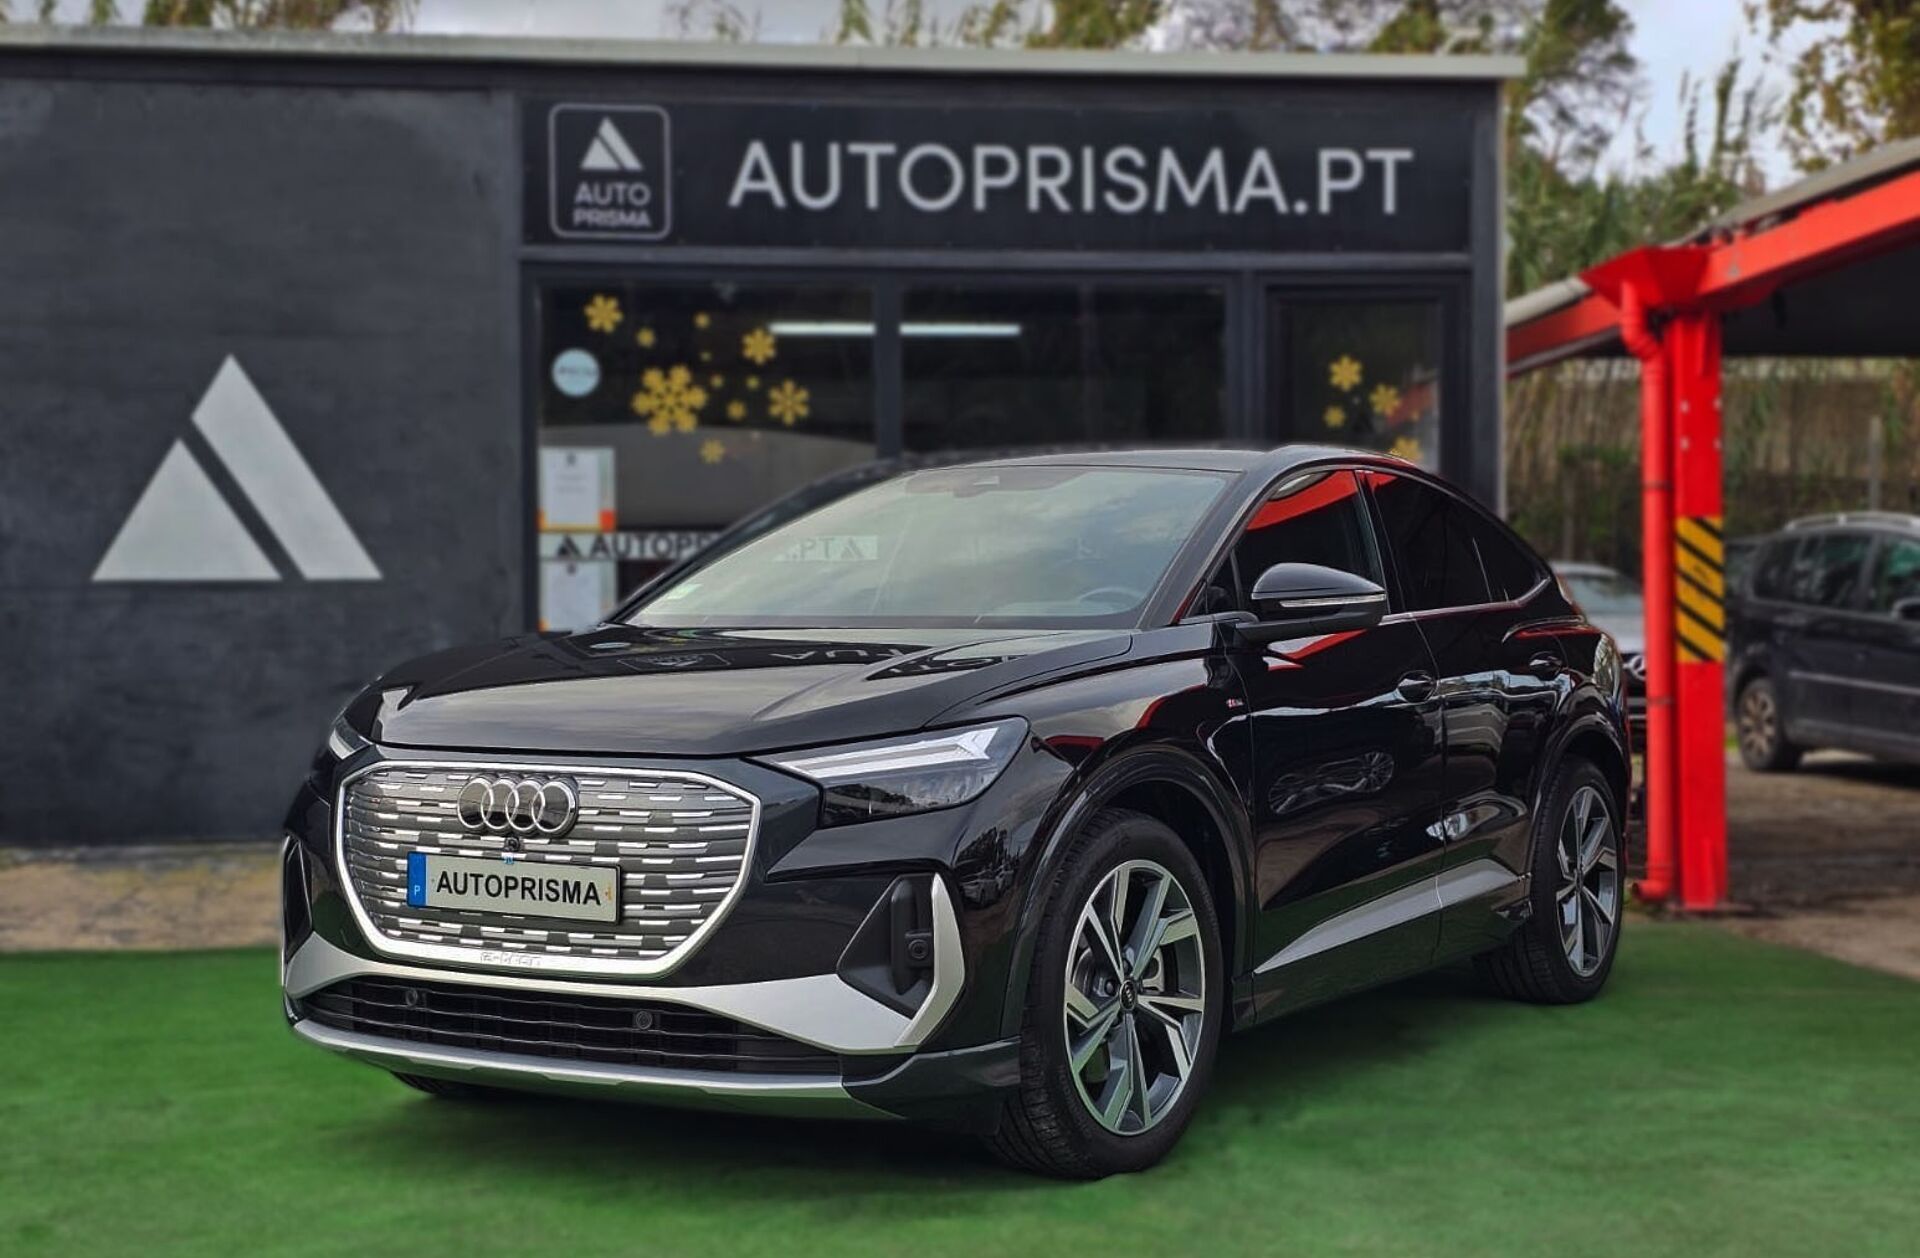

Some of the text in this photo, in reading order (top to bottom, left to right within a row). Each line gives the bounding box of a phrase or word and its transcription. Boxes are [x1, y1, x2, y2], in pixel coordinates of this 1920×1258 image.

[729, 140, 1414, 214] AUTOPRISMA.PT
[573, 181, 652, 207] AUTO
[572, 207, 653, 228] PRISMA
[413, 870, 602, 906] P AUTOPRISMA
